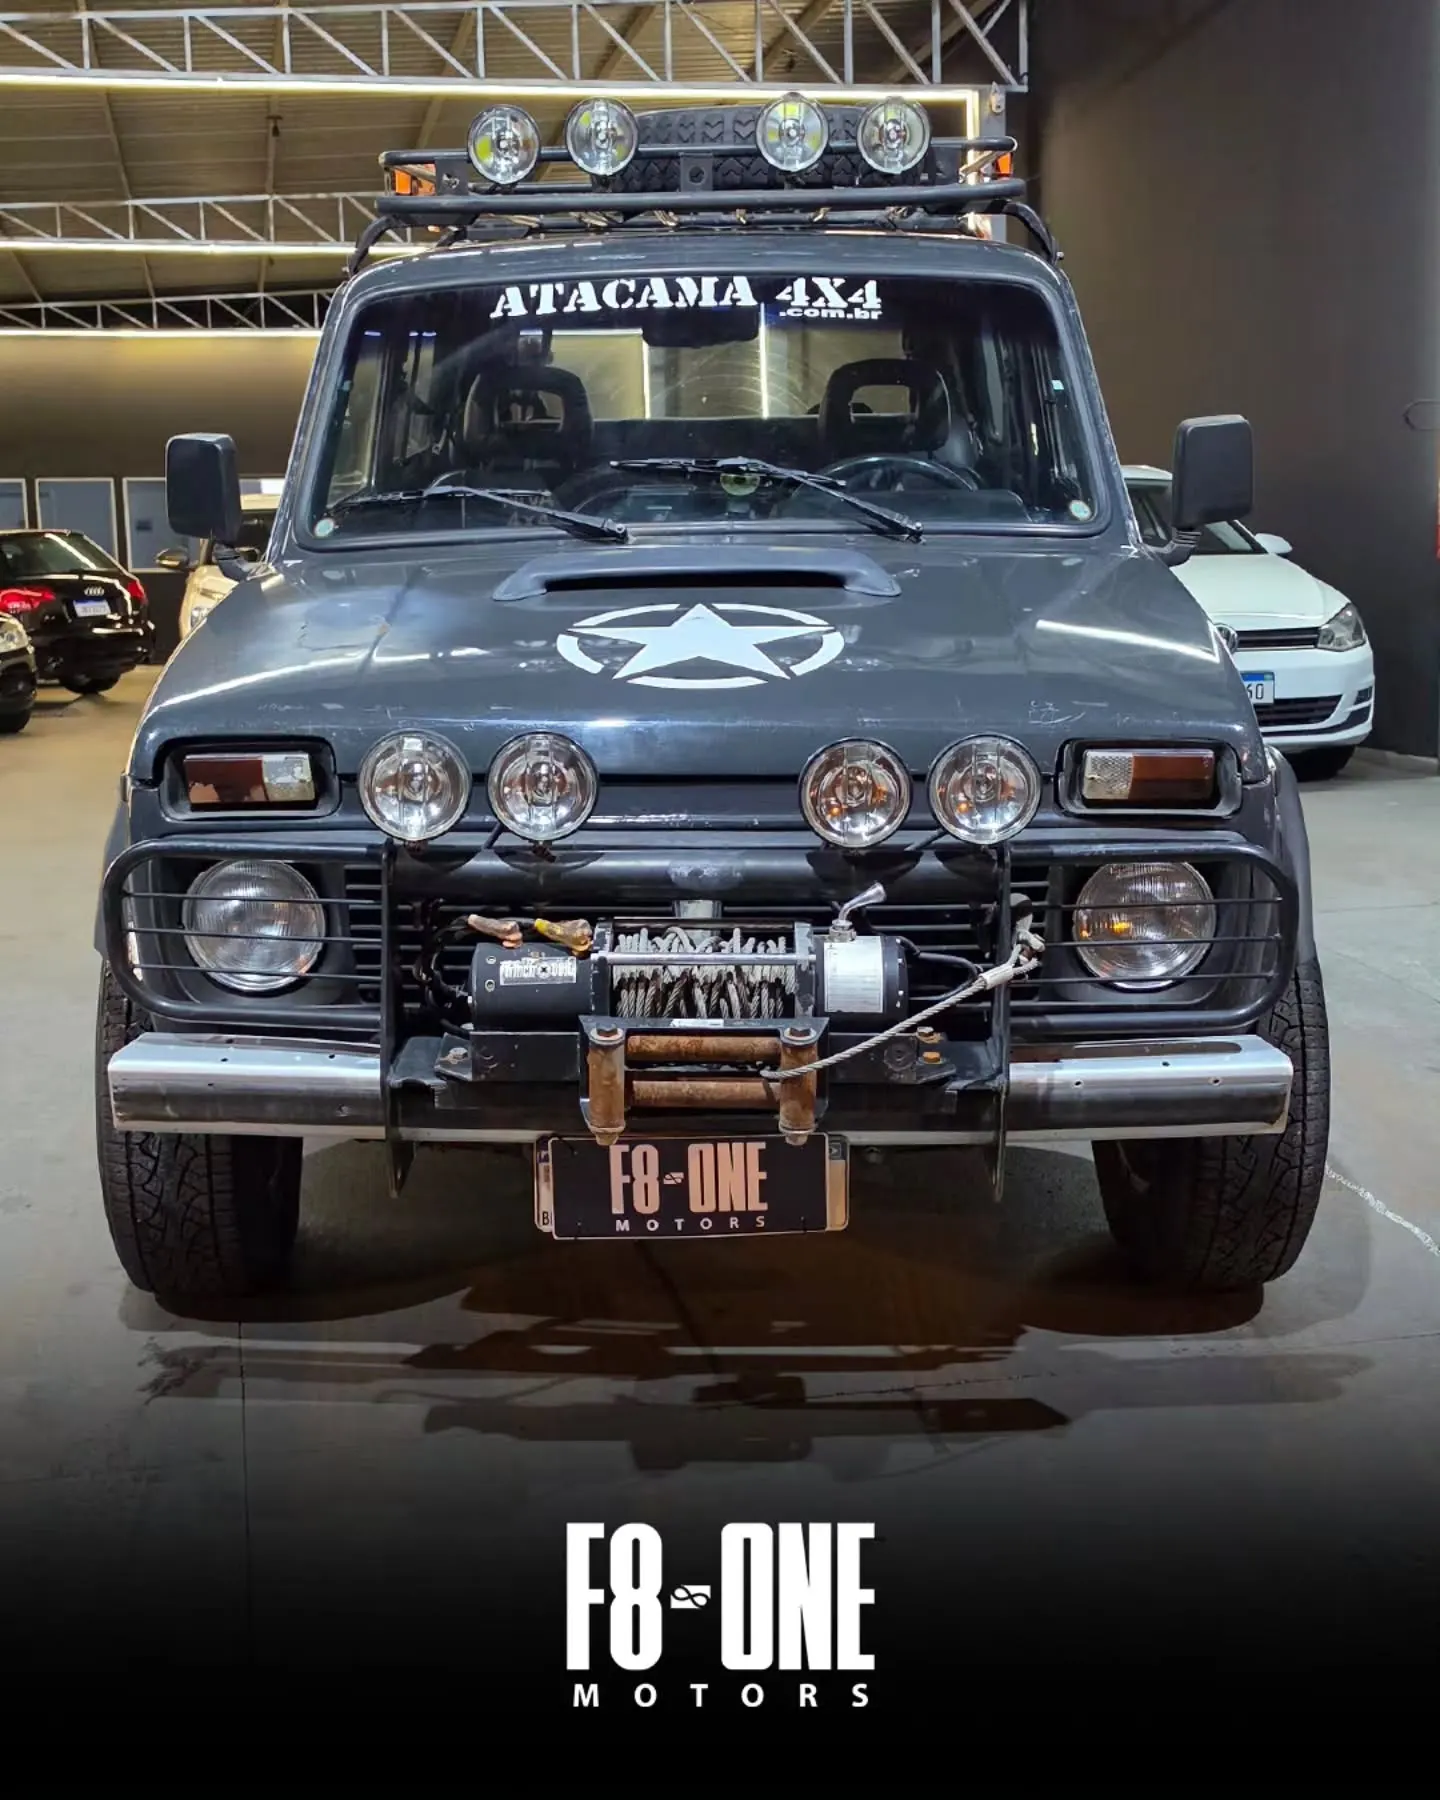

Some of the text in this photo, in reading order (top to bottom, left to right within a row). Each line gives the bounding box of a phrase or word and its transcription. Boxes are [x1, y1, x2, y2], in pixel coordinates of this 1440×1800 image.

[490, 275, 882, 319] ATACAMA 4X4
[778, 306, 882, 320] .com.br
[615, 1215, 765, 1232] MOTORS
